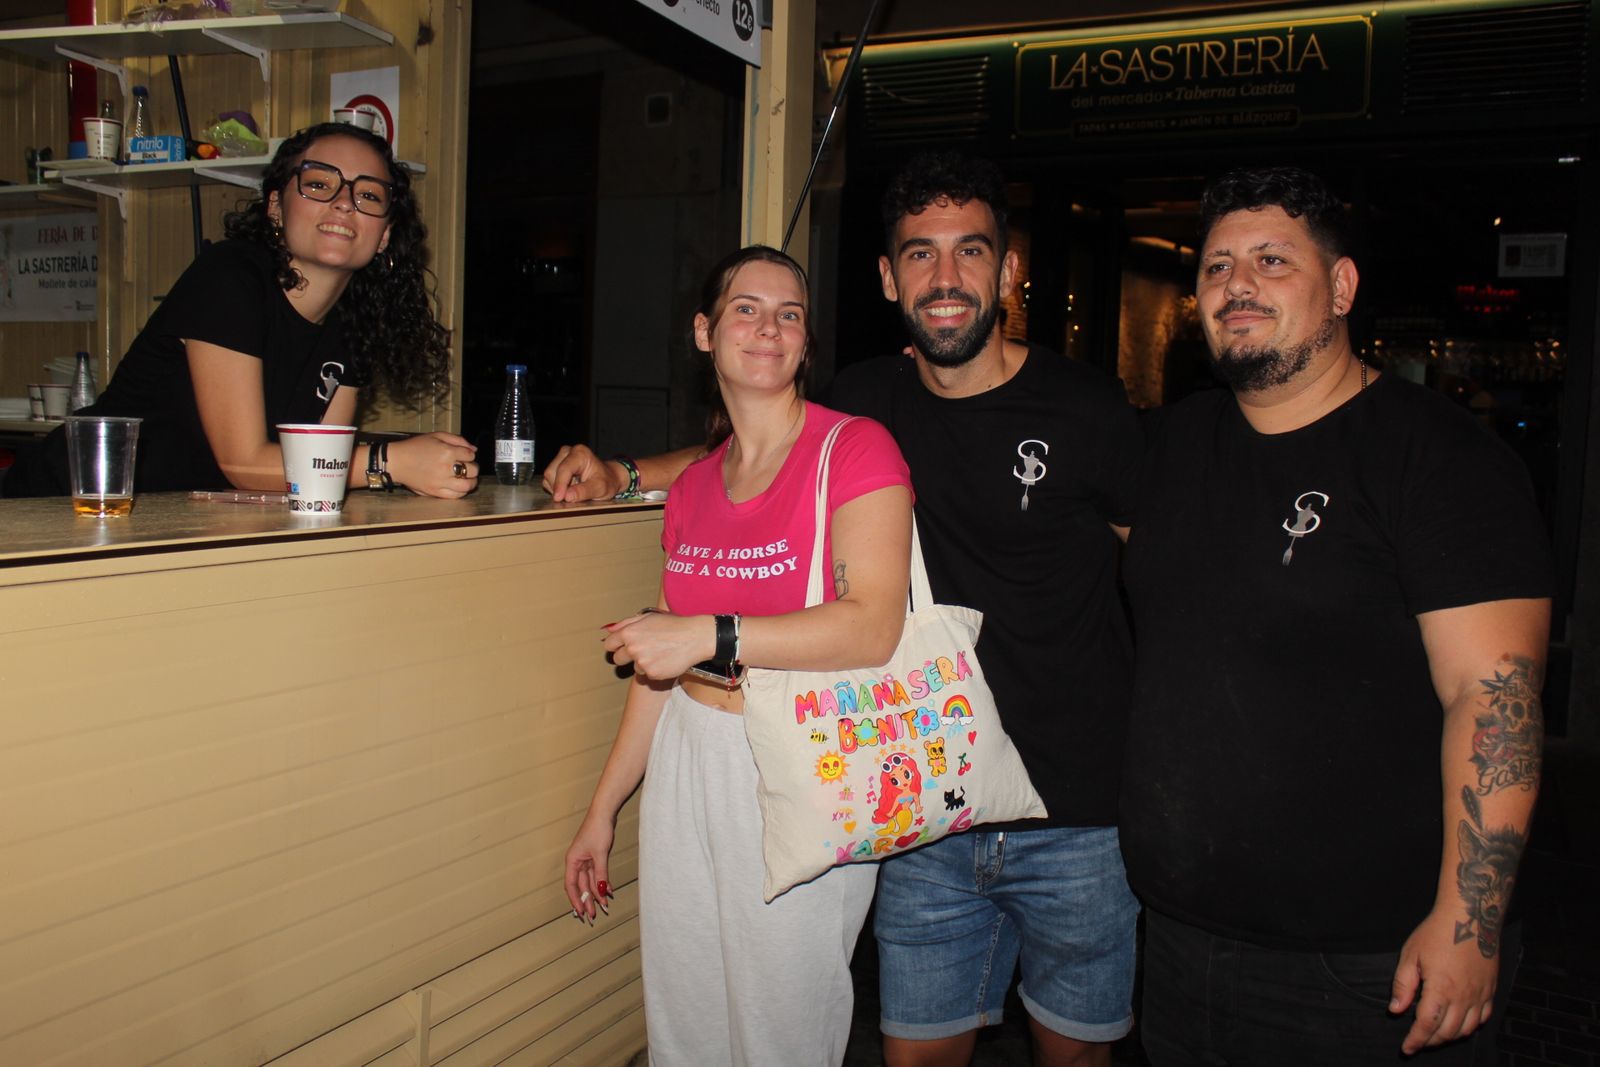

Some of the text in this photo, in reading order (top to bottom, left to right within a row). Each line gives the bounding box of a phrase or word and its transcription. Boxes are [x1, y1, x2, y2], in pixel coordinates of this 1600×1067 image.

[1048, 27, 1330, 90] LA SASTRERÍA
[1072, 80, 1297, 109] del mercado Taberna Castiza
[136, 136, 164, 150] nitrilo
[73, 225, 87, 242] DE
[18, 259, 31, 274] LA
[32, 252, 89, 273] SASTRERÍA
[38, 279, 66, 289] Mollete
[68, 278, 78, 289] de
[677, 539, 789, 560] SAVE A HORSE
[698, 565, 710, 576] A
[716, 556, 798, 580] COWBOY
[795, 651, 973, 724] MAÑANA SERÁ
